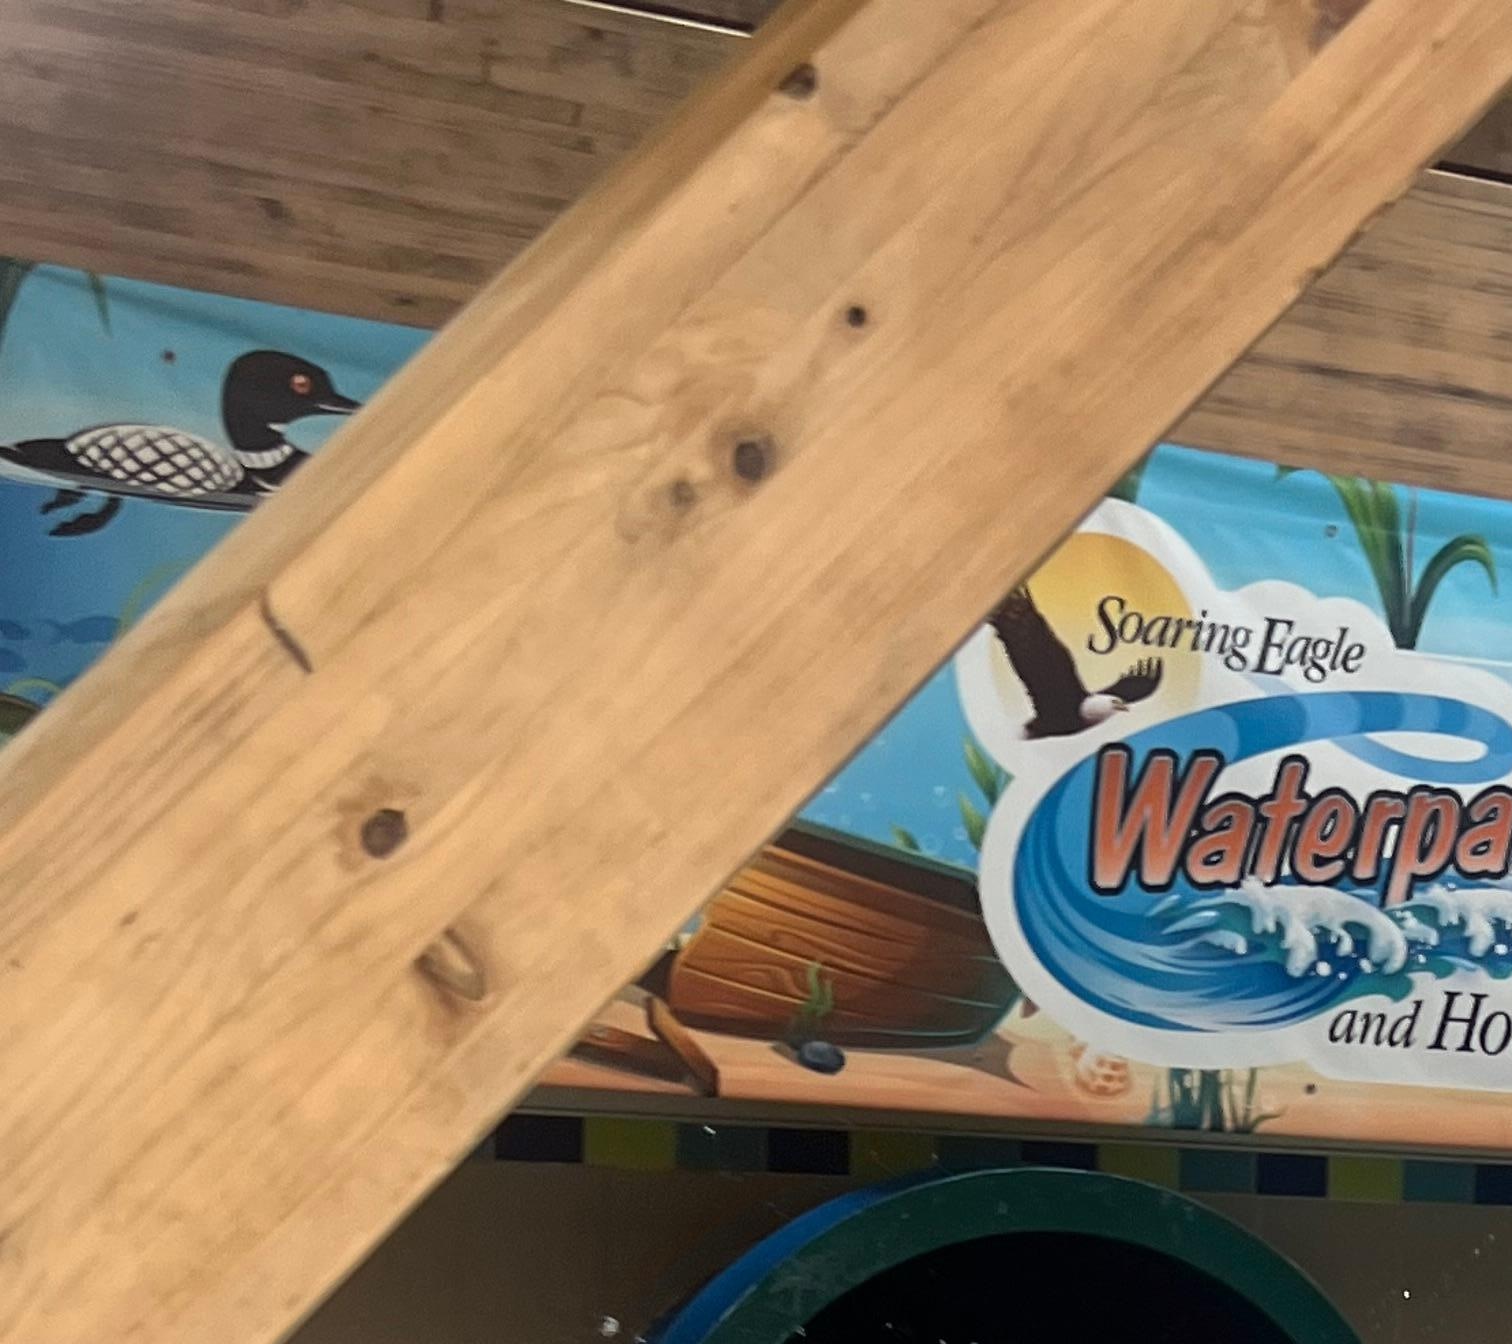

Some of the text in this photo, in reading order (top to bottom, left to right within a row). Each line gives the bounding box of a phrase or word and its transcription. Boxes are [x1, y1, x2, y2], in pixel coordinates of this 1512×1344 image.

[1088, 596, 1366, 683] Soaring Eagle
[1328, 999, 1423, 1048] and
